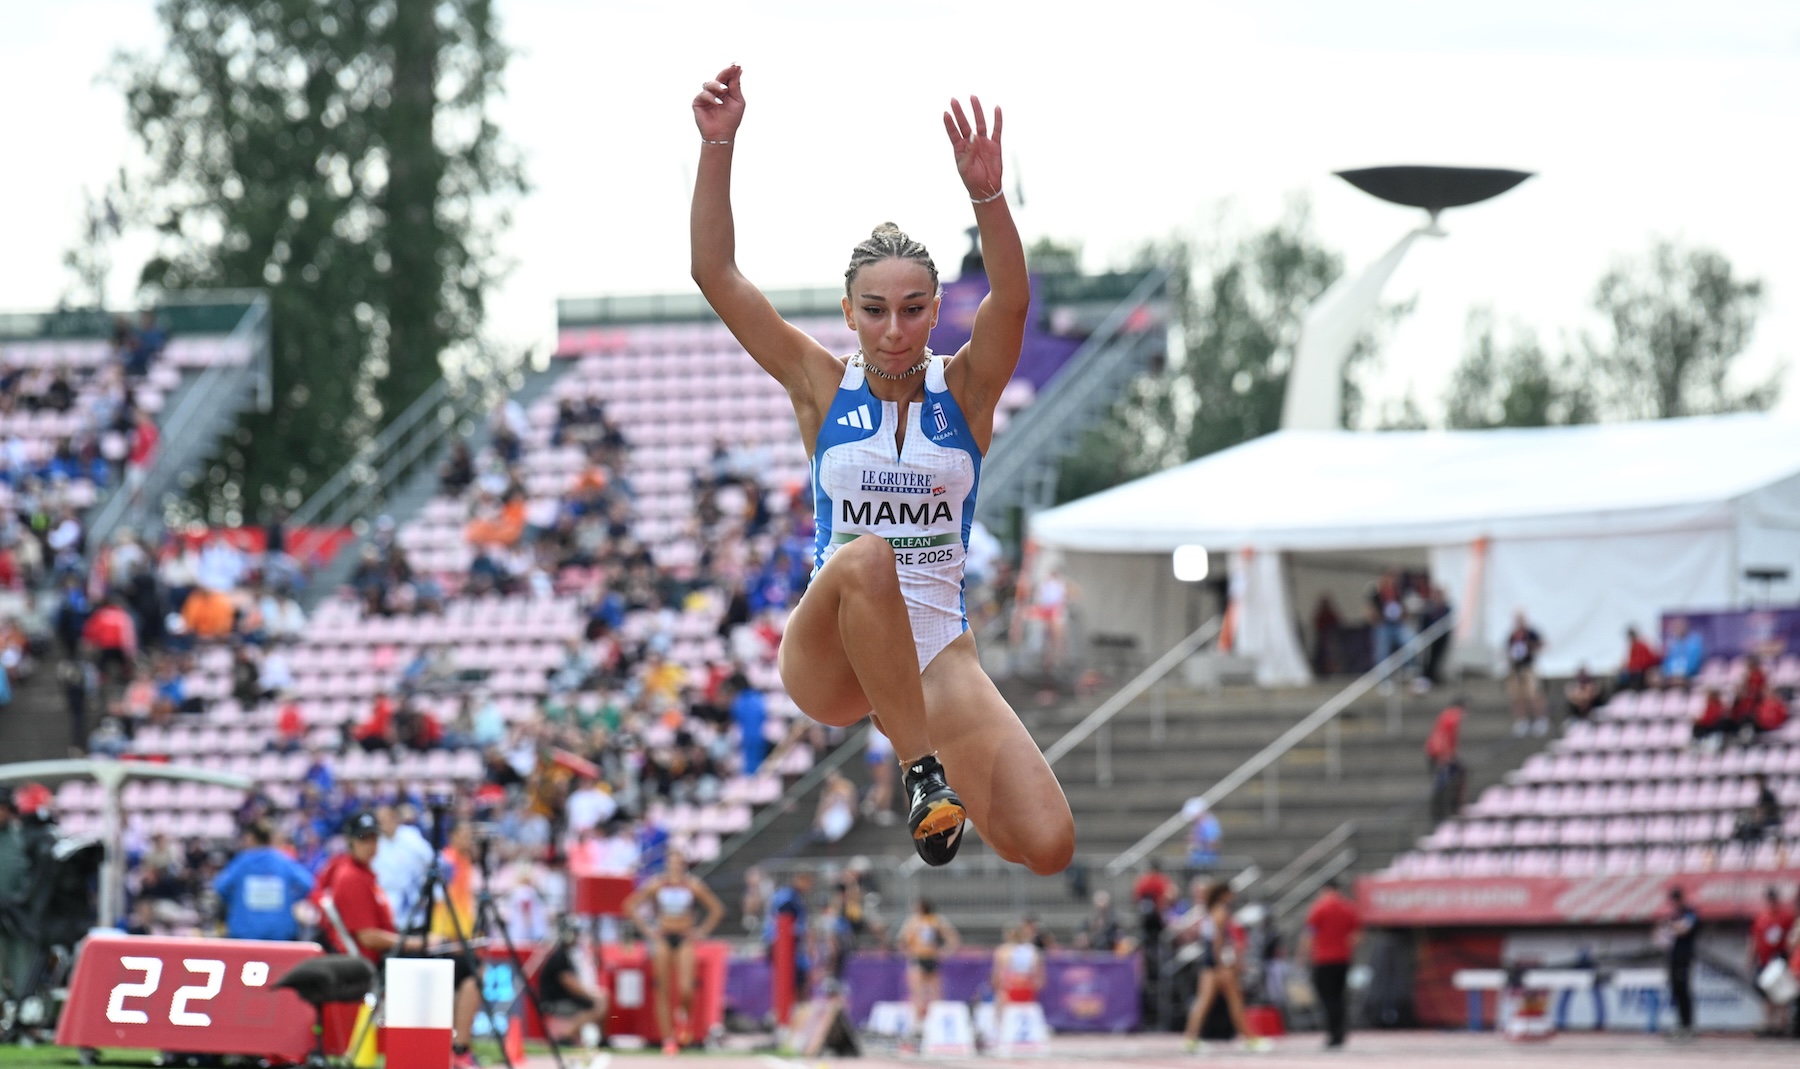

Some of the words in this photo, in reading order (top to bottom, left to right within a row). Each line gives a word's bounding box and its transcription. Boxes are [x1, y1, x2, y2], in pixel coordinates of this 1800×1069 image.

[862, 470, 876, 484] LE
[862, 485, 930, 494] SWITZERLAND
[842, 499, 953, 526] MAMA
[918, 549, 953, 564] 2025
